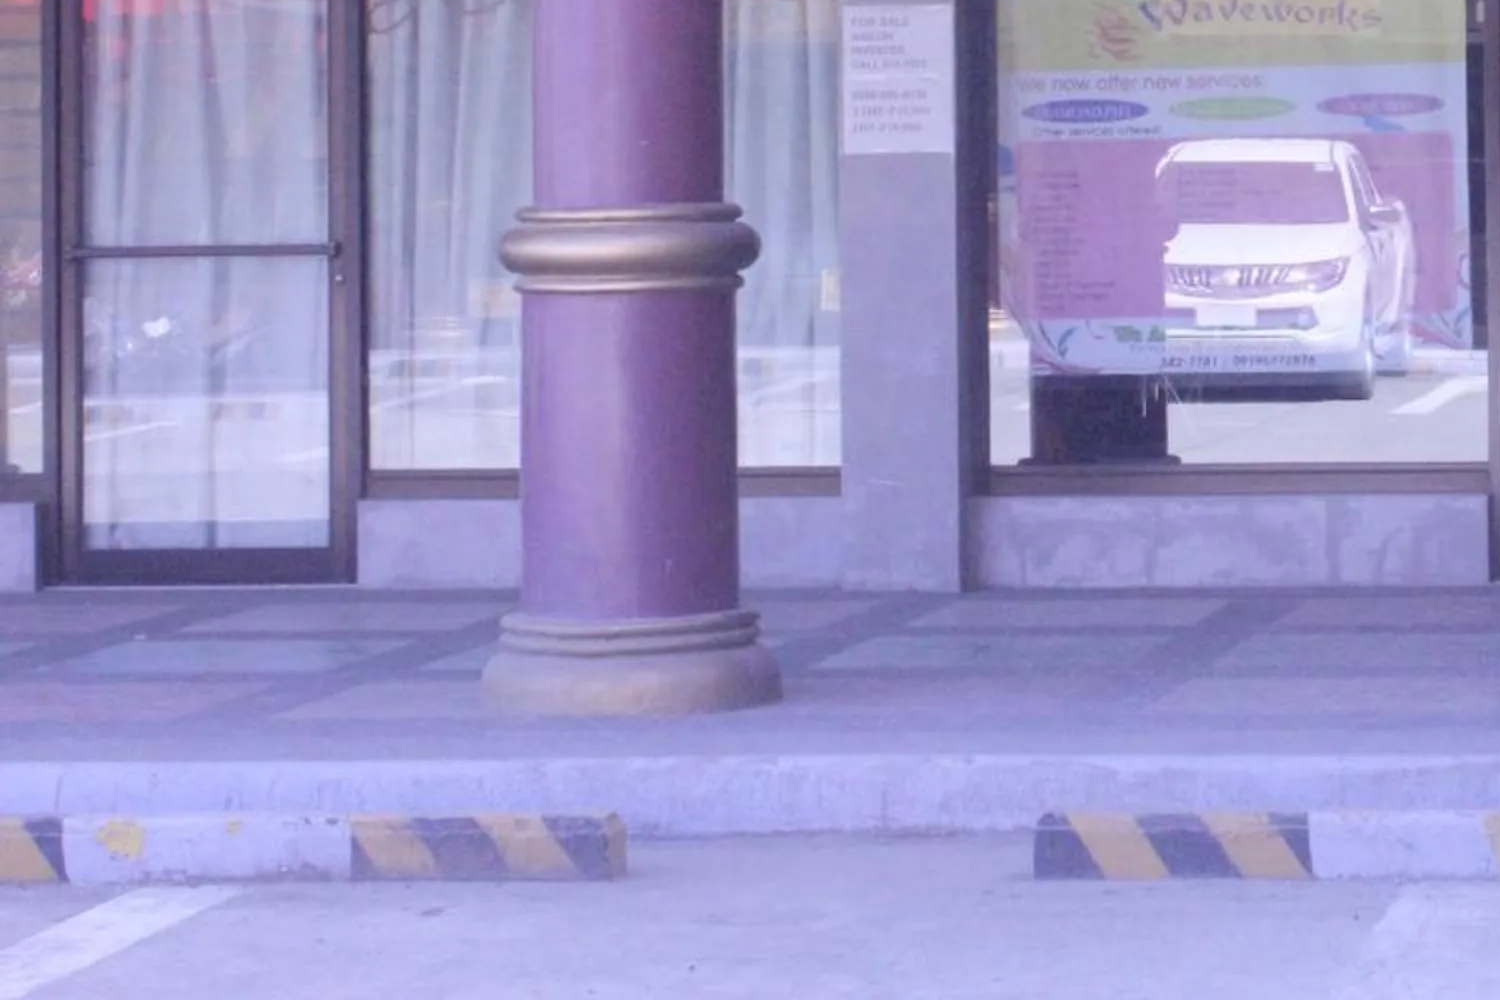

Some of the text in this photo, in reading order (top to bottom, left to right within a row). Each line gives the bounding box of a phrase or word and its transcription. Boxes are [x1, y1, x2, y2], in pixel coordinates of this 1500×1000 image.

[1051, 77, 1091, 91] now
[1096, 74, 1137, 91] offer
[1143, 76, 1182, 90] new
